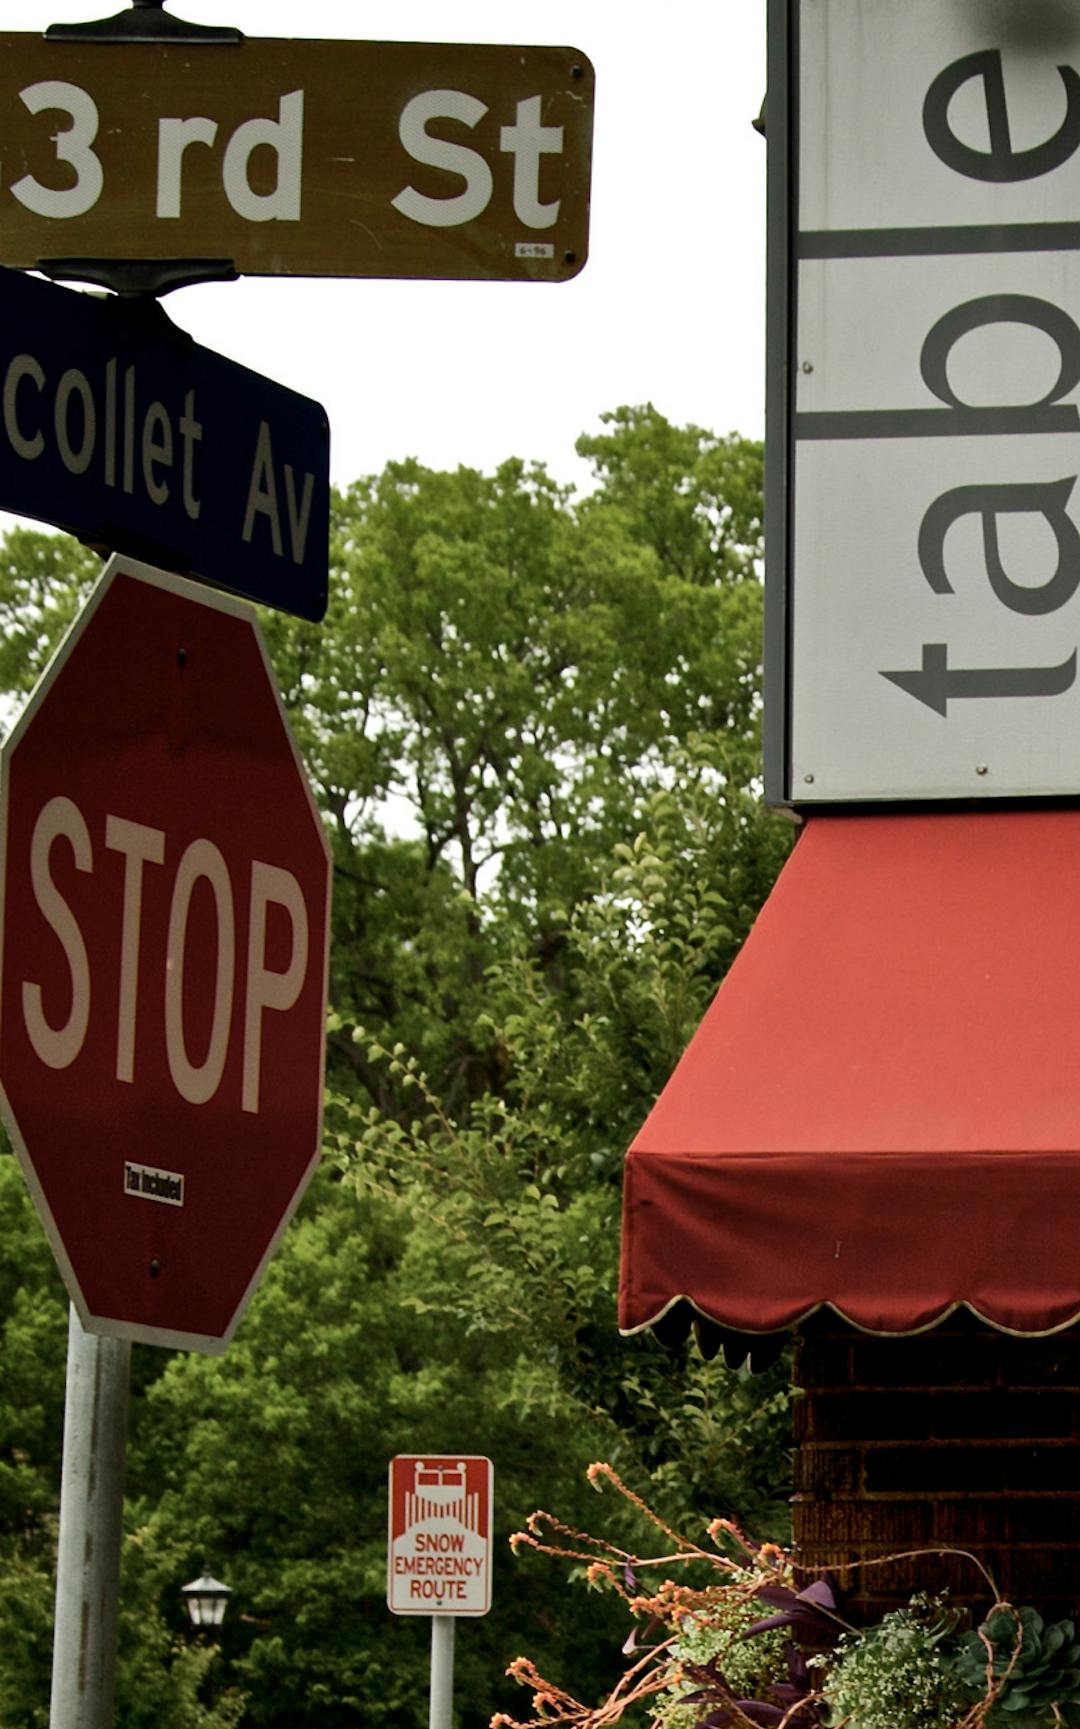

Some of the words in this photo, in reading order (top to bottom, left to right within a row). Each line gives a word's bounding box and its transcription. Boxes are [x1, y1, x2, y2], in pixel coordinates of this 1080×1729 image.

[391, 88, 564, 230] St
[4, 353, 203, 520] collet
[241, 421, 315, 565] Av
[22, 796, 309, 1114] STOP
[395, 1556, 484, 1576] EMERGENCY
[415, 1533, 465, 1553] SNOW
[410, 1580, 467, 1599] ROUTE
